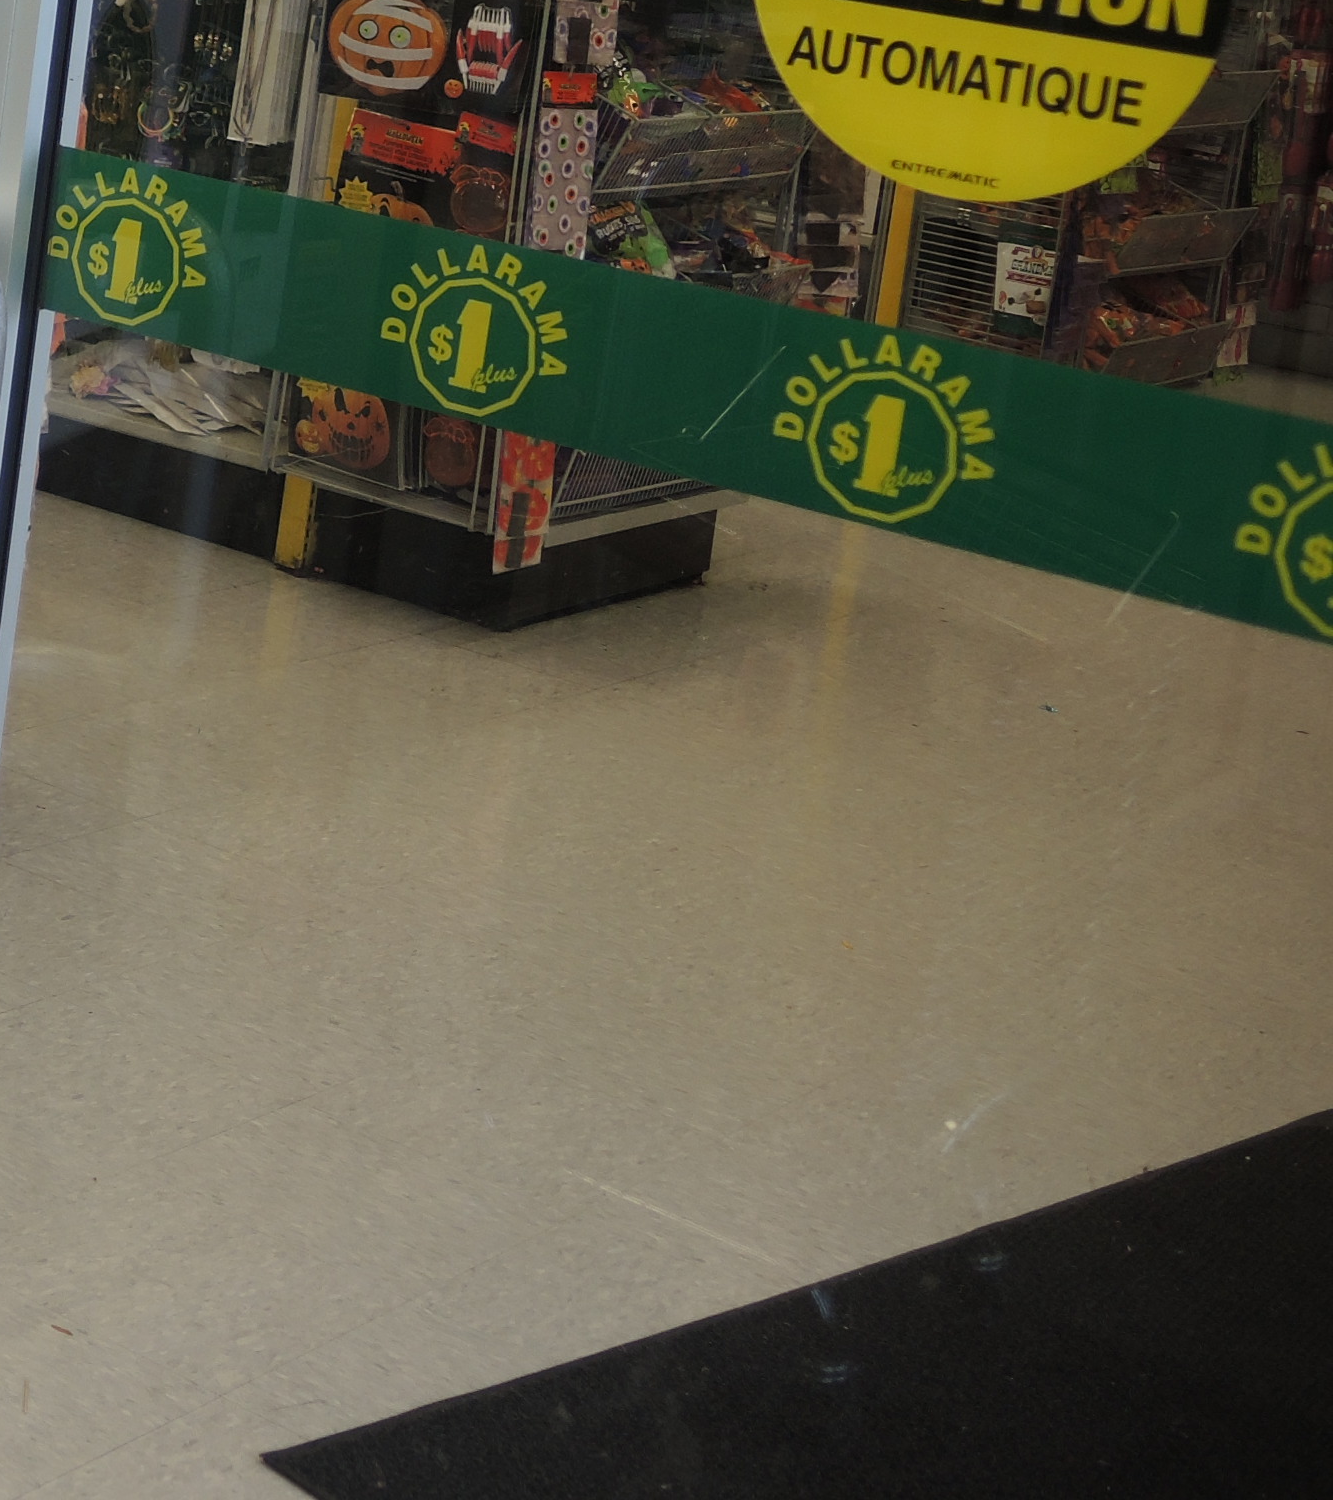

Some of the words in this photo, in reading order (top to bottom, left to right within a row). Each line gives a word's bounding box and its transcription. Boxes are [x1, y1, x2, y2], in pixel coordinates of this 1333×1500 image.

[786, 25, 1146, 127] AUTOMATIQUE
[46, 166, 208, 289] DOLLARAMA
[87, 216, 143, 305] $1
[124, 277, 165, 303] plus
[380, 243, 568, 378] DOLLARAMA
[427, 298, 492, 394] $1
[470, 362, 518, 393] plus
[773, 334, 996, 481] DOLLARAMA
[828, 393, 906, 498] $1
